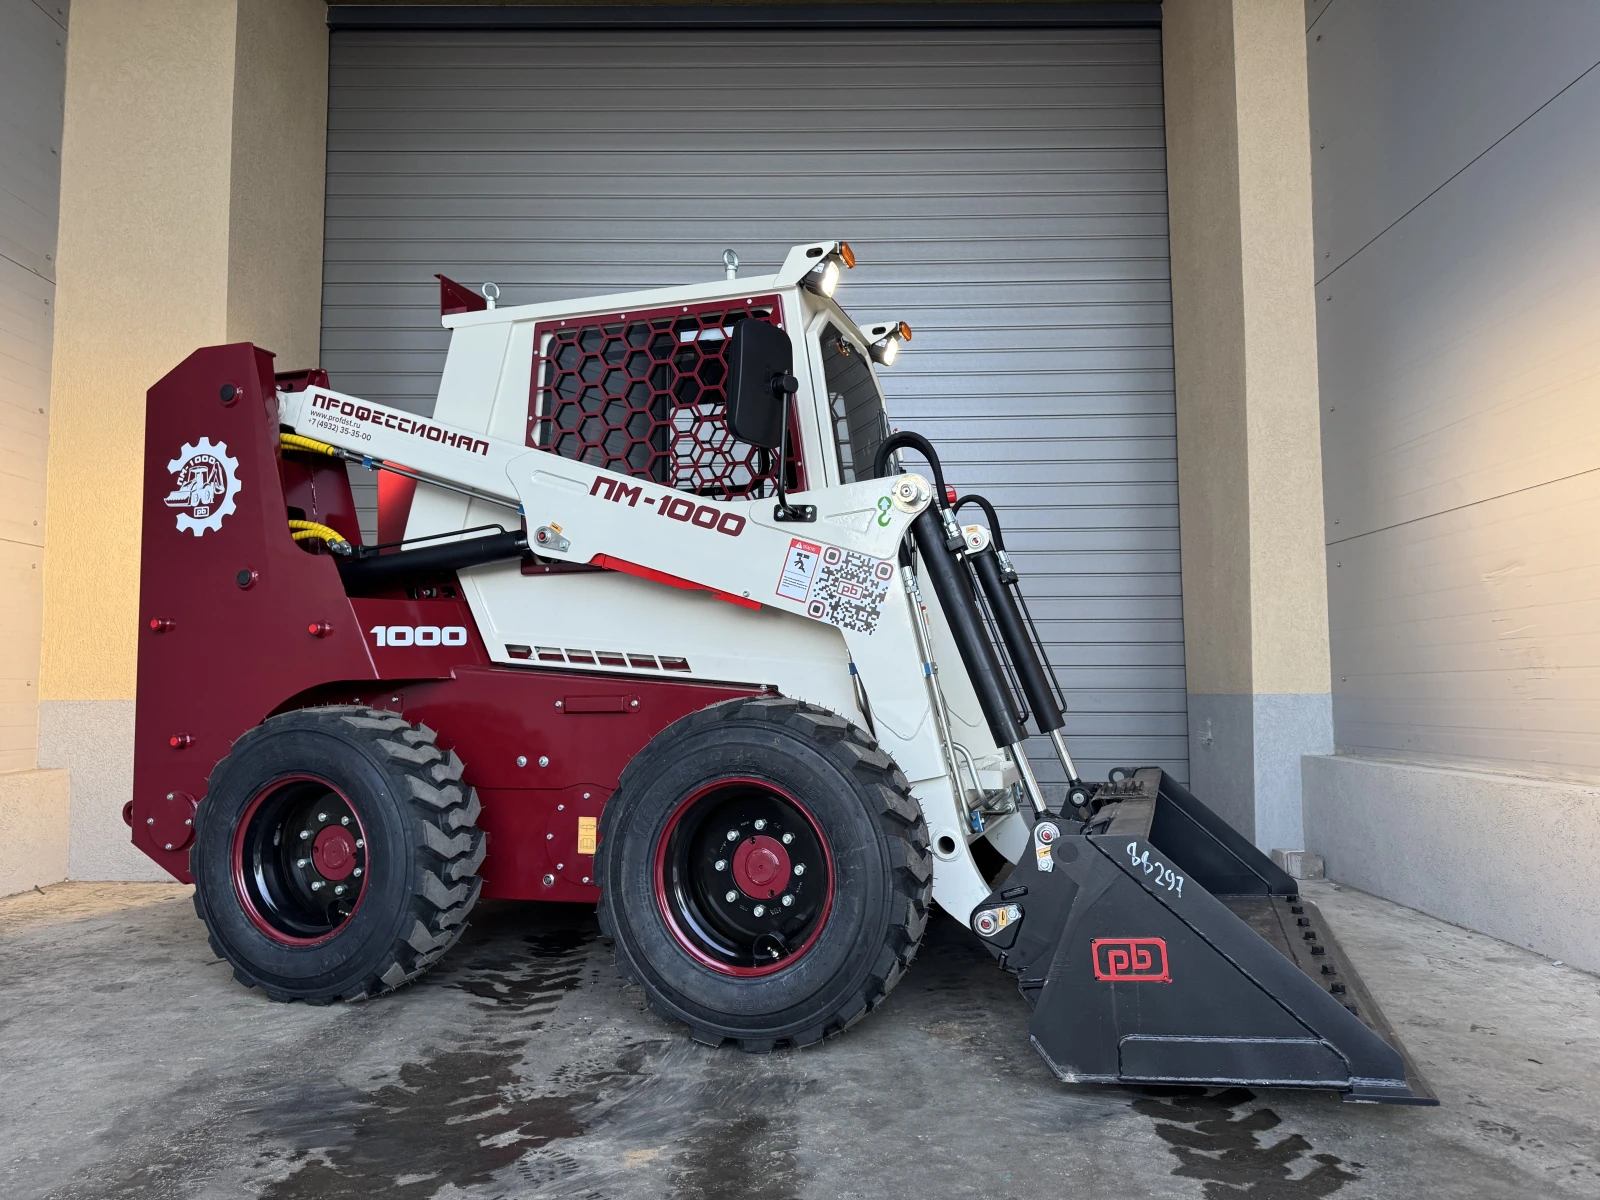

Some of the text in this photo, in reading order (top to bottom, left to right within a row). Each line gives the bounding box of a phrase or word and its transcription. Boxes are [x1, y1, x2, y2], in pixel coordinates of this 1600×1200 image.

[310, 410, 361, 429] www.profdst.ru
[316, 419, 339, 434] (4932)
[339, 427, 372, 441] 35-35-00
[589, 475, 747, 537] ПМ-1000
[370, 626, 467, 646] 1000
